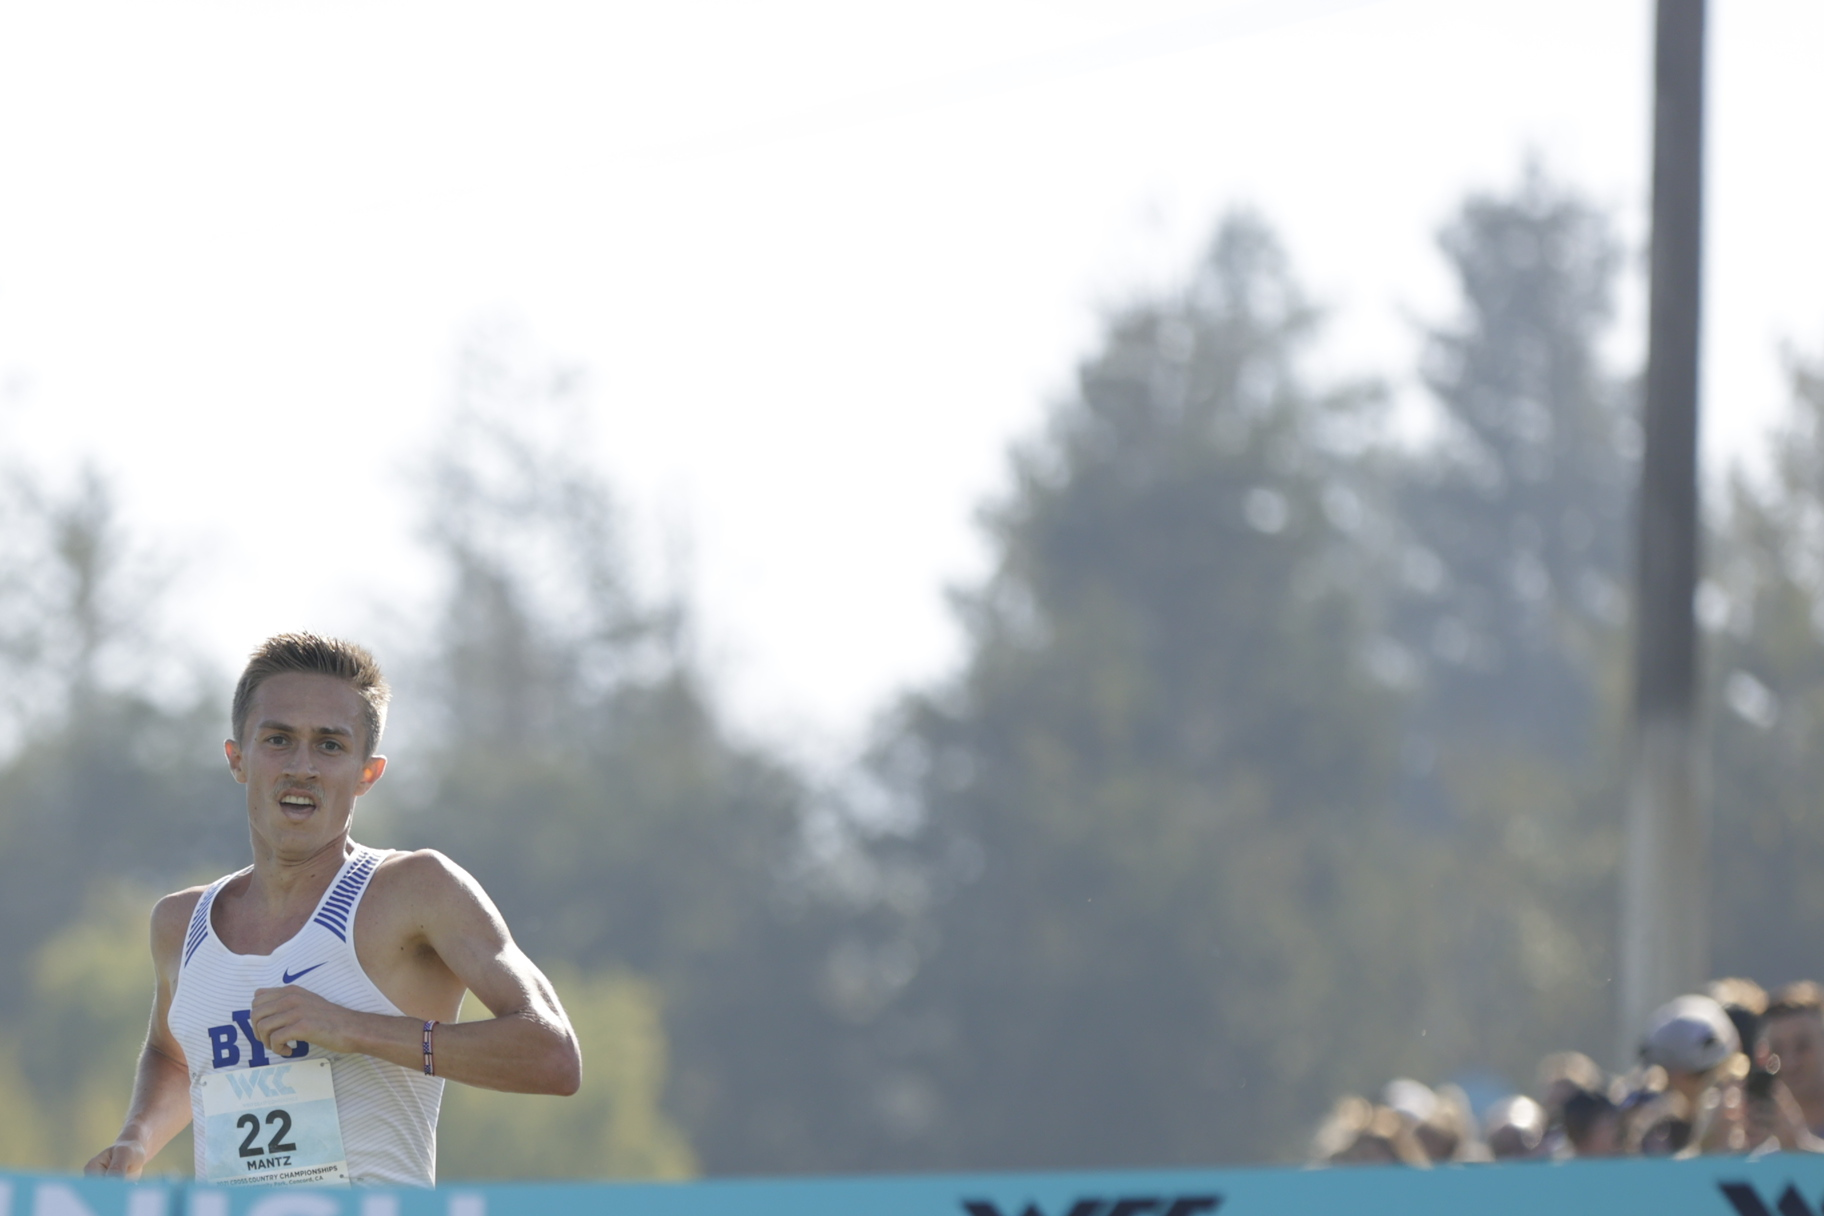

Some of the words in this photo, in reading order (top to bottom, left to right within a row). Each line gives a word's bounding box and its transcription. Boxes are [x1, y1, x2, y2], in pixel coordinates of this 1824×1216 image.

[225, 1065, 297, 1100] WCC
[236, 1109, 297, 1158] 22
[247, 1156, 292, 1171] MANTZ
[249, 1174, 277, 1183] COUNTRY
[279, 1165, 338, 1179] CHAMPIONSHIPS
